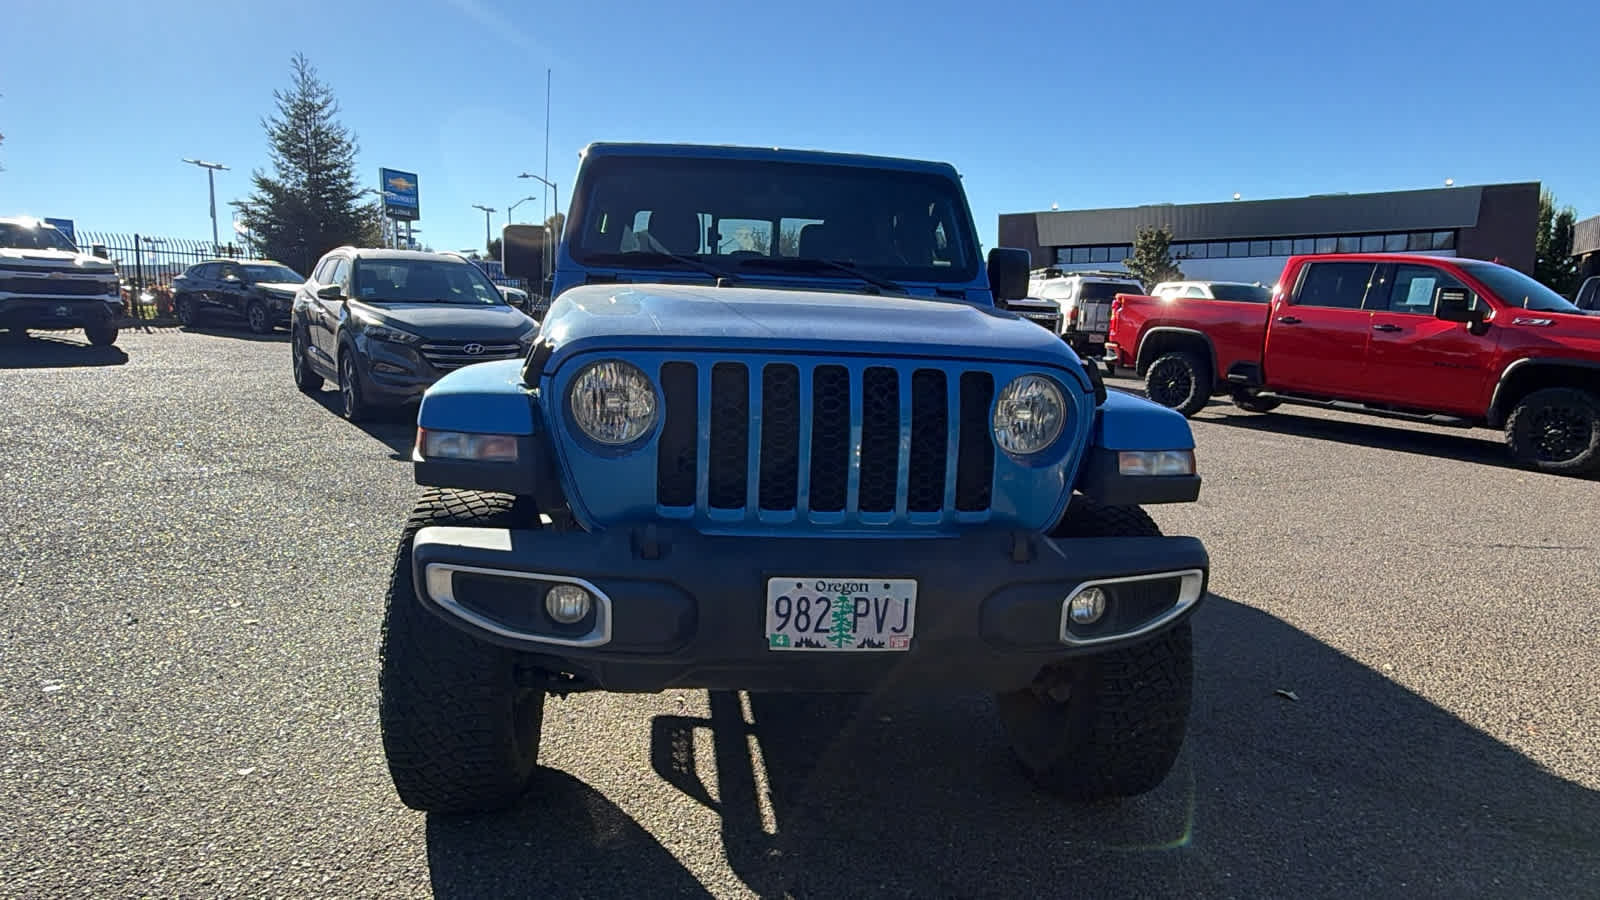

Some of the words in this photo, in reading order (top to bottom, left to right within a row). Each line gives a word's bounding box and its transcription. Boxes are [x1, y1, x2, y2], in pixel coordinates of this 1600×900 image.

[815, 580, 869, 595] Oregon
[775, 595, 832, 633] 982
[852, 597, 909, 634] PVJ
